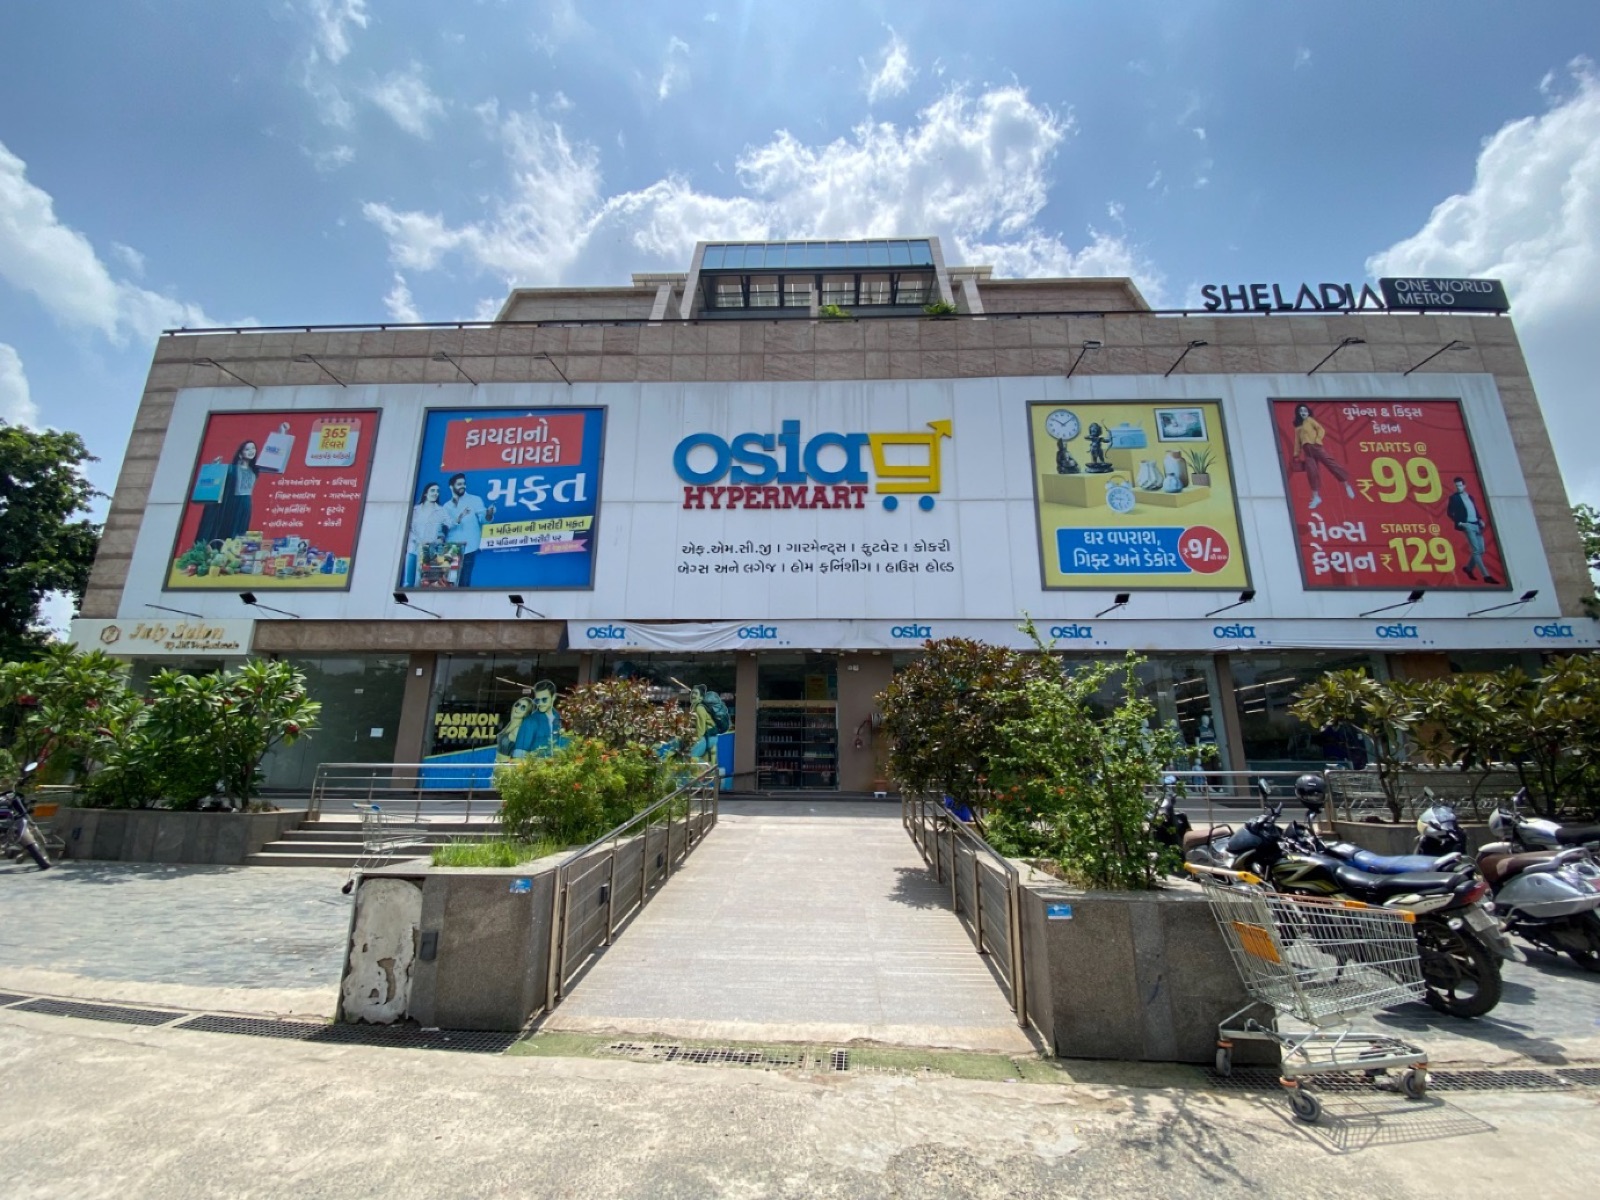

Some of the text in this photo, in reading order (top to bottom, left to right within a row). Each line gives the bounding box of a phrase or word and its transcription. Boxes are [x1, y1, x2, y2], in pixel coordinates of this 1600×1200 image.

[1394, 279, 1493, 293] ONE WORLD
[1200, 282, 1385, 310] SHELADIA
[1398, 292, 1455, 305] METRO
[1380, 407, 1390, 417] &
[323, 428, 347, 438] 365
[465, 418, 548, 449] ફાયદાનો
[501, 437, 561, 465] વાયદો
[673, 420, 869, 486] osia
[1359, 441, 1427, 455] STARTS @
[487, 472, 587, 511] મફત
[682, 486, 869, 510] HYPERMART
[1307, 512, 1367, 542] મેન્સ
[1380, 523, 1441, 537] STARTS @
[1083, 531, 1104, 545] ઘર
[1113, 547, 1141, 567] અને
[1309, 542, 1377, 576] ફેશન
[714, 560, 739, 573] અને
[743, 559, 777, 573] લગેજ
[790, 559, 814, 573] હોમ
[925, 558, 955, 573] હોલ્ડ
[586, 624, 626, 640] osia
[737, 624, 777, 640] osia
[891, 623, 932, 639] osia
[1050, 623, 1092, 639] osia
[1213, 623, 1256, 639] osia
[1375, 623, 1418, 639] osia
[1533, 623, 1574, 639] osia
[434, 712, 500, 726] FASHION
[438, 726, 497, 739] FOR ALL
